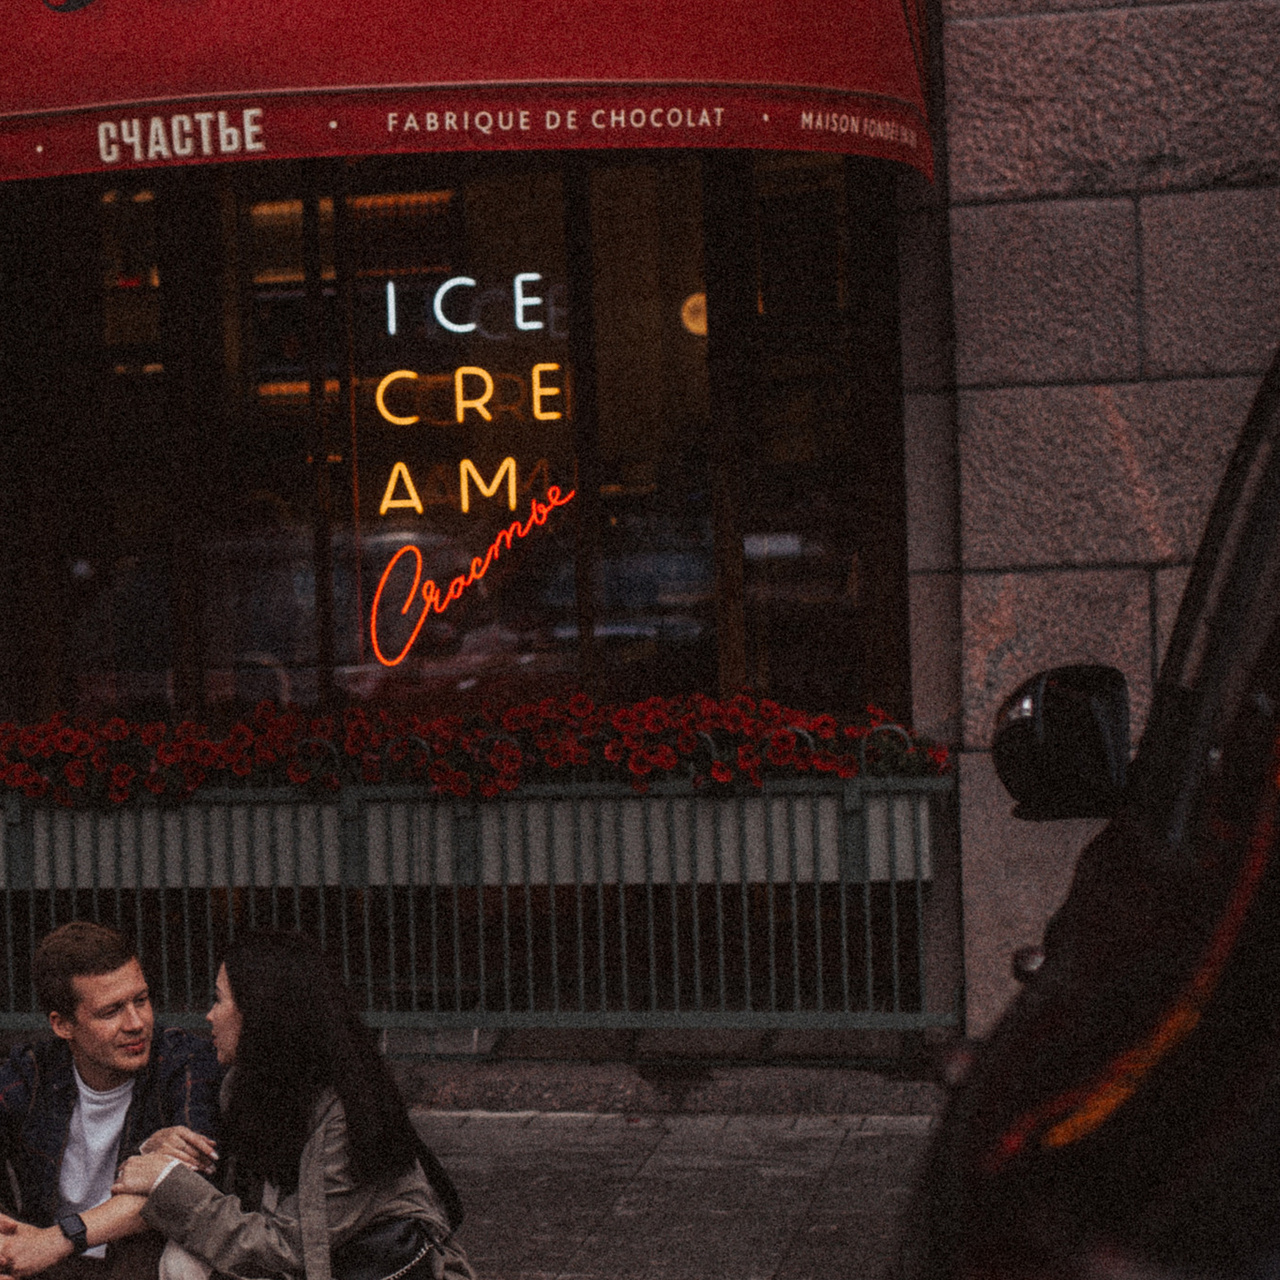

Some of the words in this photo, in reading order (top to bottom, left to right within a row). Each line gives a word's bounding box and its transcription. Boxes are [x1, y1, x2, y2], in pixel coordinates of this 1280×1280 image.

[97, 107, 266, 164] СЧАСТЬЕ
[387, 110, 531, 135] FABRIQUE
[545, 110, 578, 131] DE
[591, 107, 725, 130] CHOCOLAT
[800, 111, 860, 134] MAISON
[386, 272, 544, 335] ICE
[375, 362, 563, 426] CRE
[379, 456, 517, 515] AM
